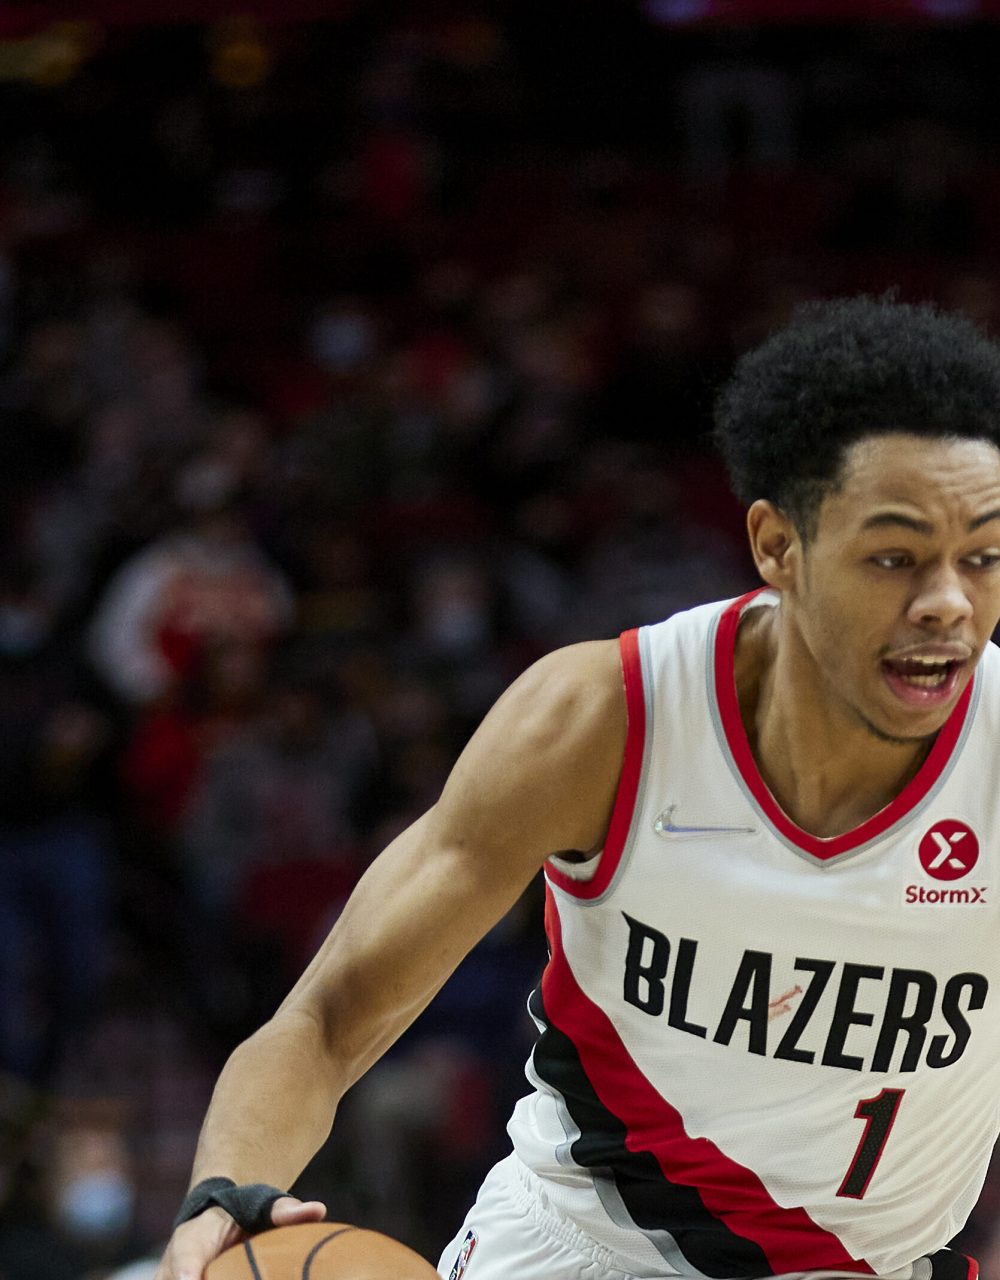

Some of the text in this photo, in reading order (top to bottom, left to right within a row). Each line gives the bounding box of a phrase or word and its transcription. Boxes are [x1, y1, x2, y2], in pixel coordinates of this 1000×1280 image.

[905, 884, 989, 904] StormX
[621, 911, 988, 1073] BLAZERS
[835, 1088, 906, 1200] 1
